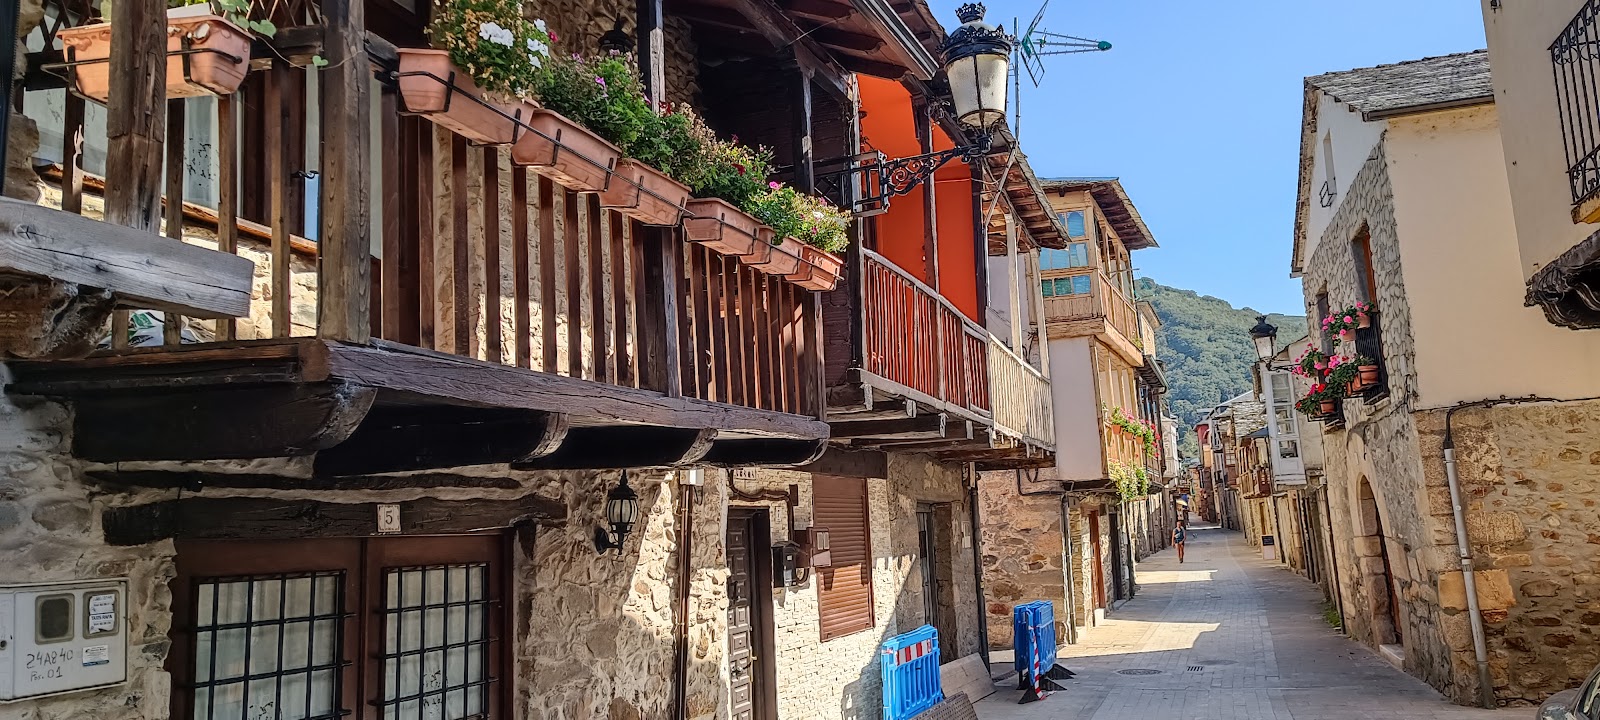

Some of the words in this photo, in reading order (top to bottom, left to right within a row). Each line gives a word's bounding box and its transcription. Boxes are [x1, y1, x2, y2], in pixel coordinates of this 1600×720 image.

[385, 510, 393, 524] 5
[26, 648, 73, 669] 24A840
[47, 666, 63, 679] 01
